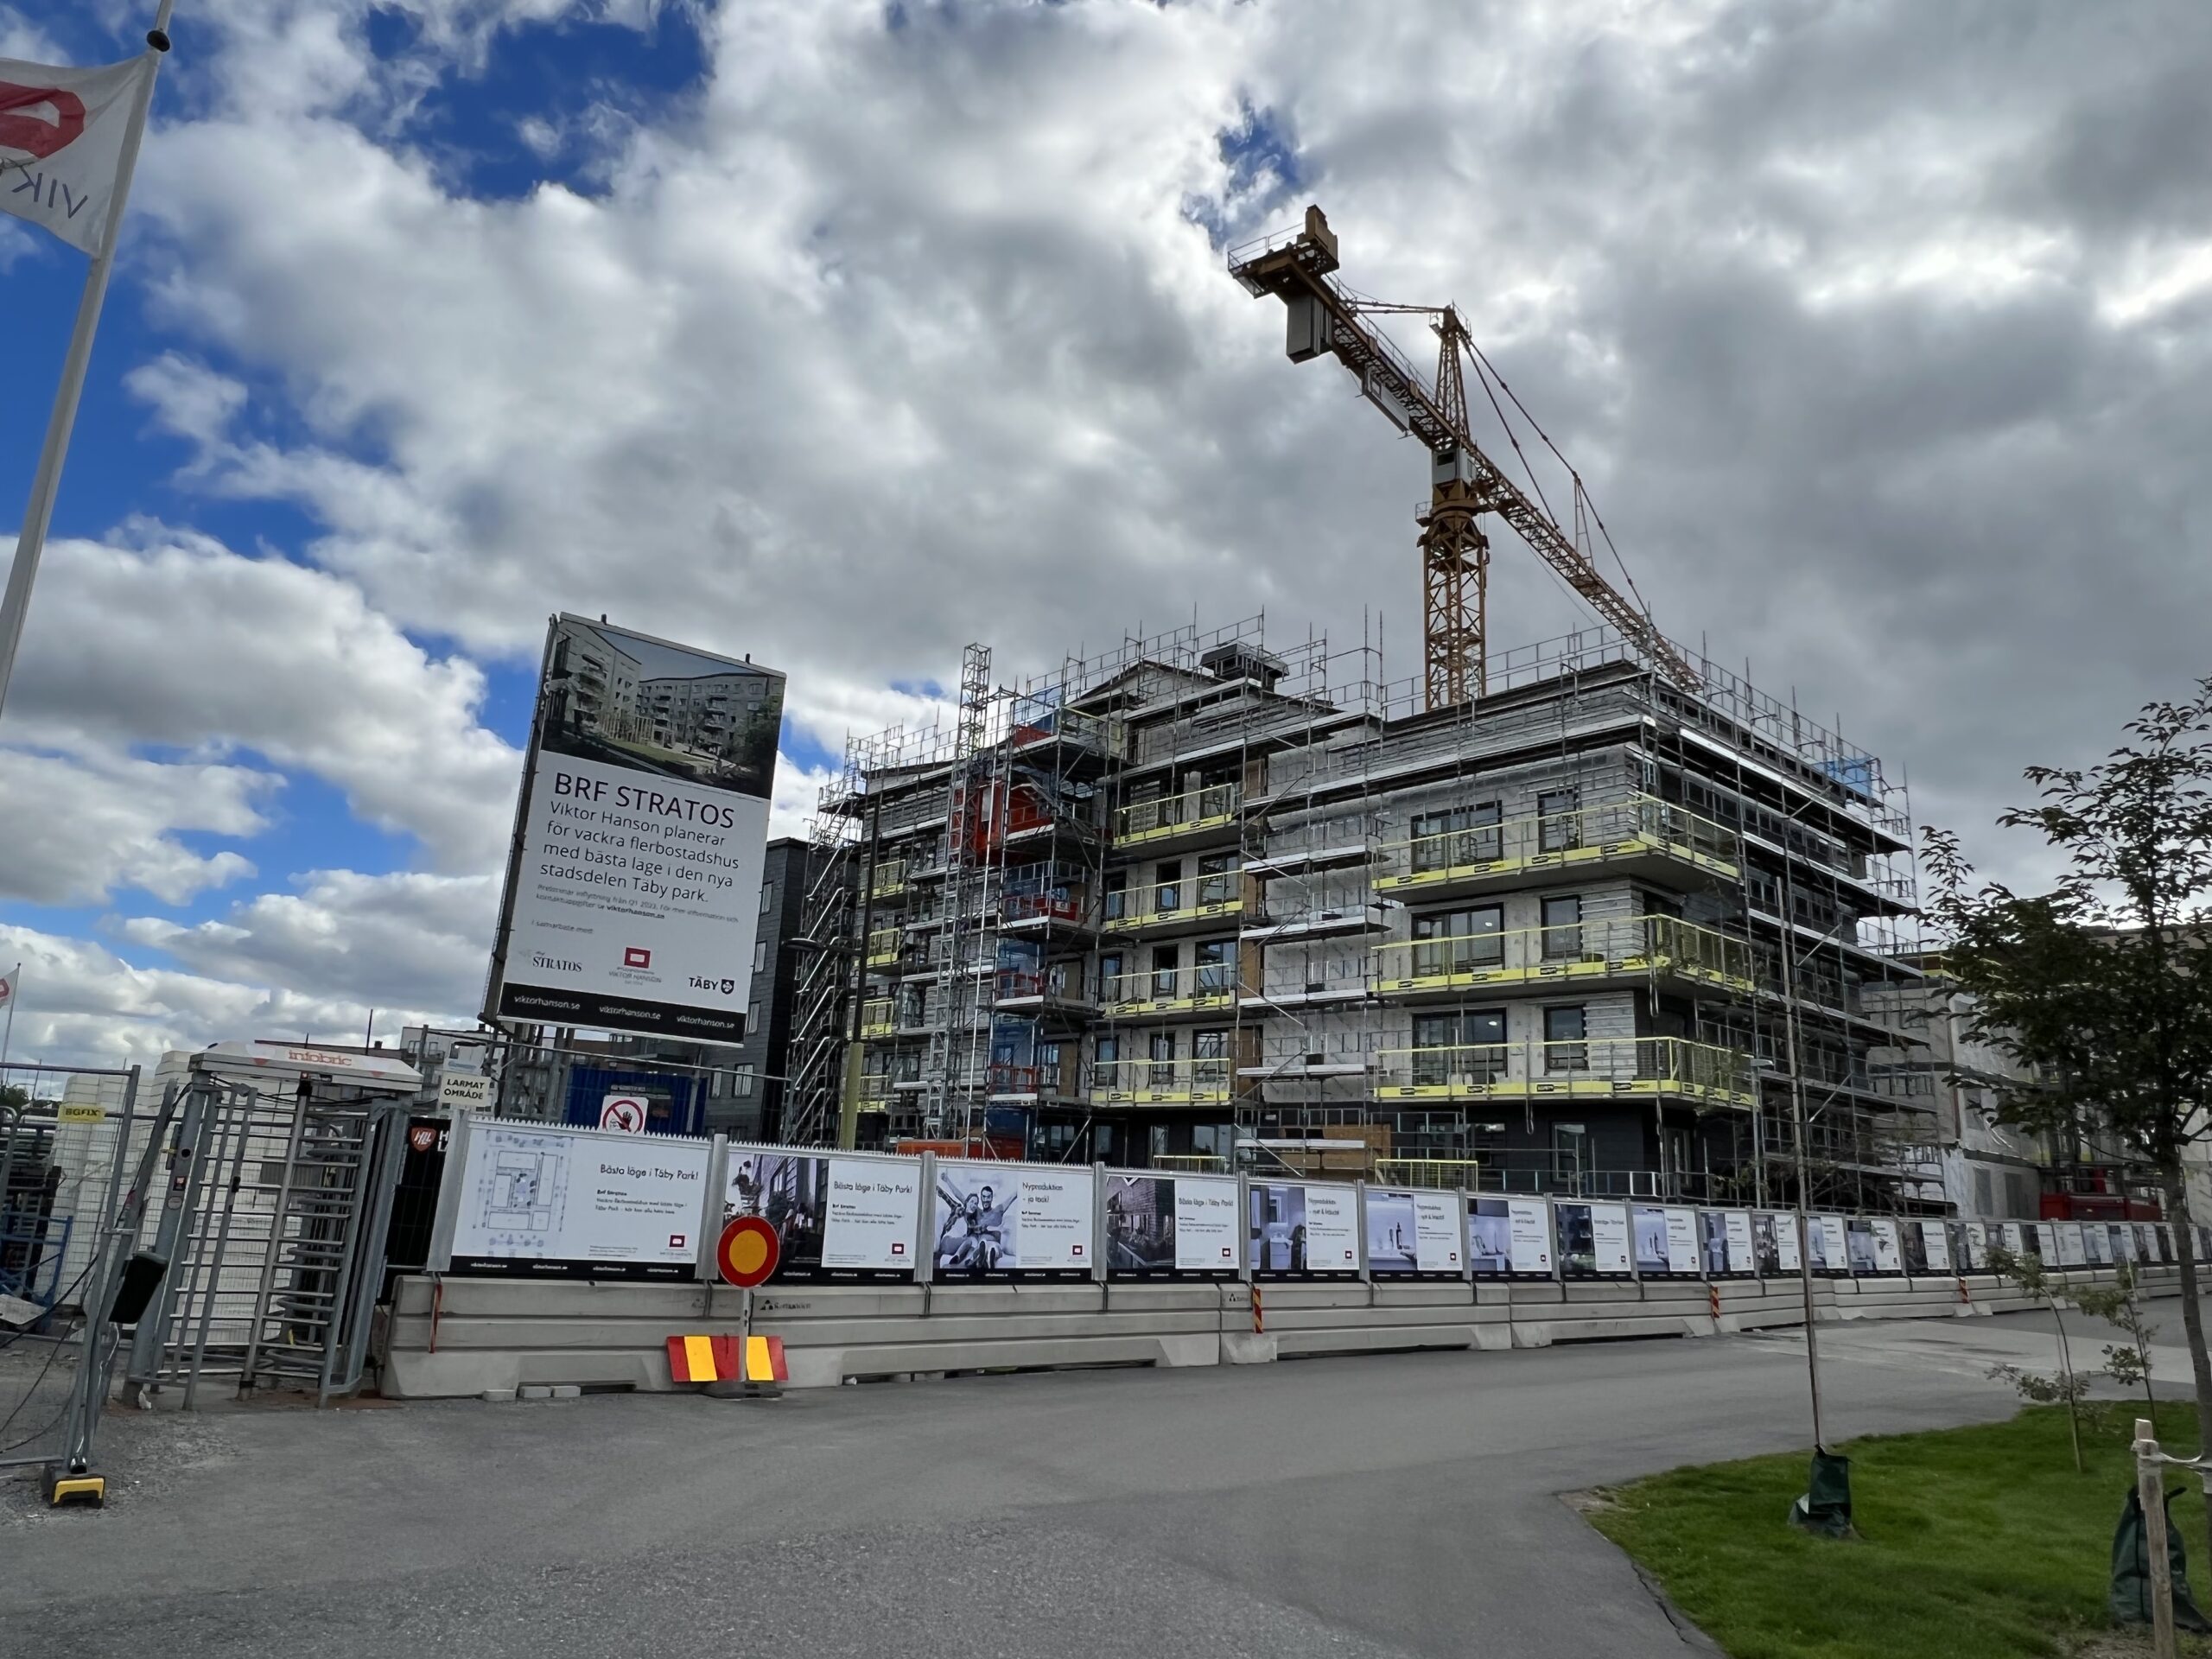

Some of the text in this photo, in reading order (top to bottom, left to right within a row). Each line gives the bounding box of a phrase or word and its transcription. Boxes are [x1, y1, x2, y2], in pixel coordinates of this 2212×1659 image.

[555, 772, 608, 802] BRF
[615, 785, 734, 829] STRATOS
[550, 801, 726, 846] Viktor Hanson planerar
[547, 820, 739, 869] för vackra flerbostadshus
[540, 864, 709, 902] stadsdelen Täby park.
[543, 843, 733, 889] med bästa läge i den nya
[532, 957, 582, 972] STRATOS
[689, 976, 719, 990] TÄBY
[514, 995, 735, 1029] viktorhanson.se viktorhanson.se viktorhanson.se
[289, 1050, 352, 1066] infobric
[444, 1087, 483, 1100] OMRÅDE
[601, 1164, 625, 1175] Bästa
[627, 1166, 646, 1179] läge
[654, 1168, 674, 1180] Täby
[677, 1171, 698, 1180] Park!
